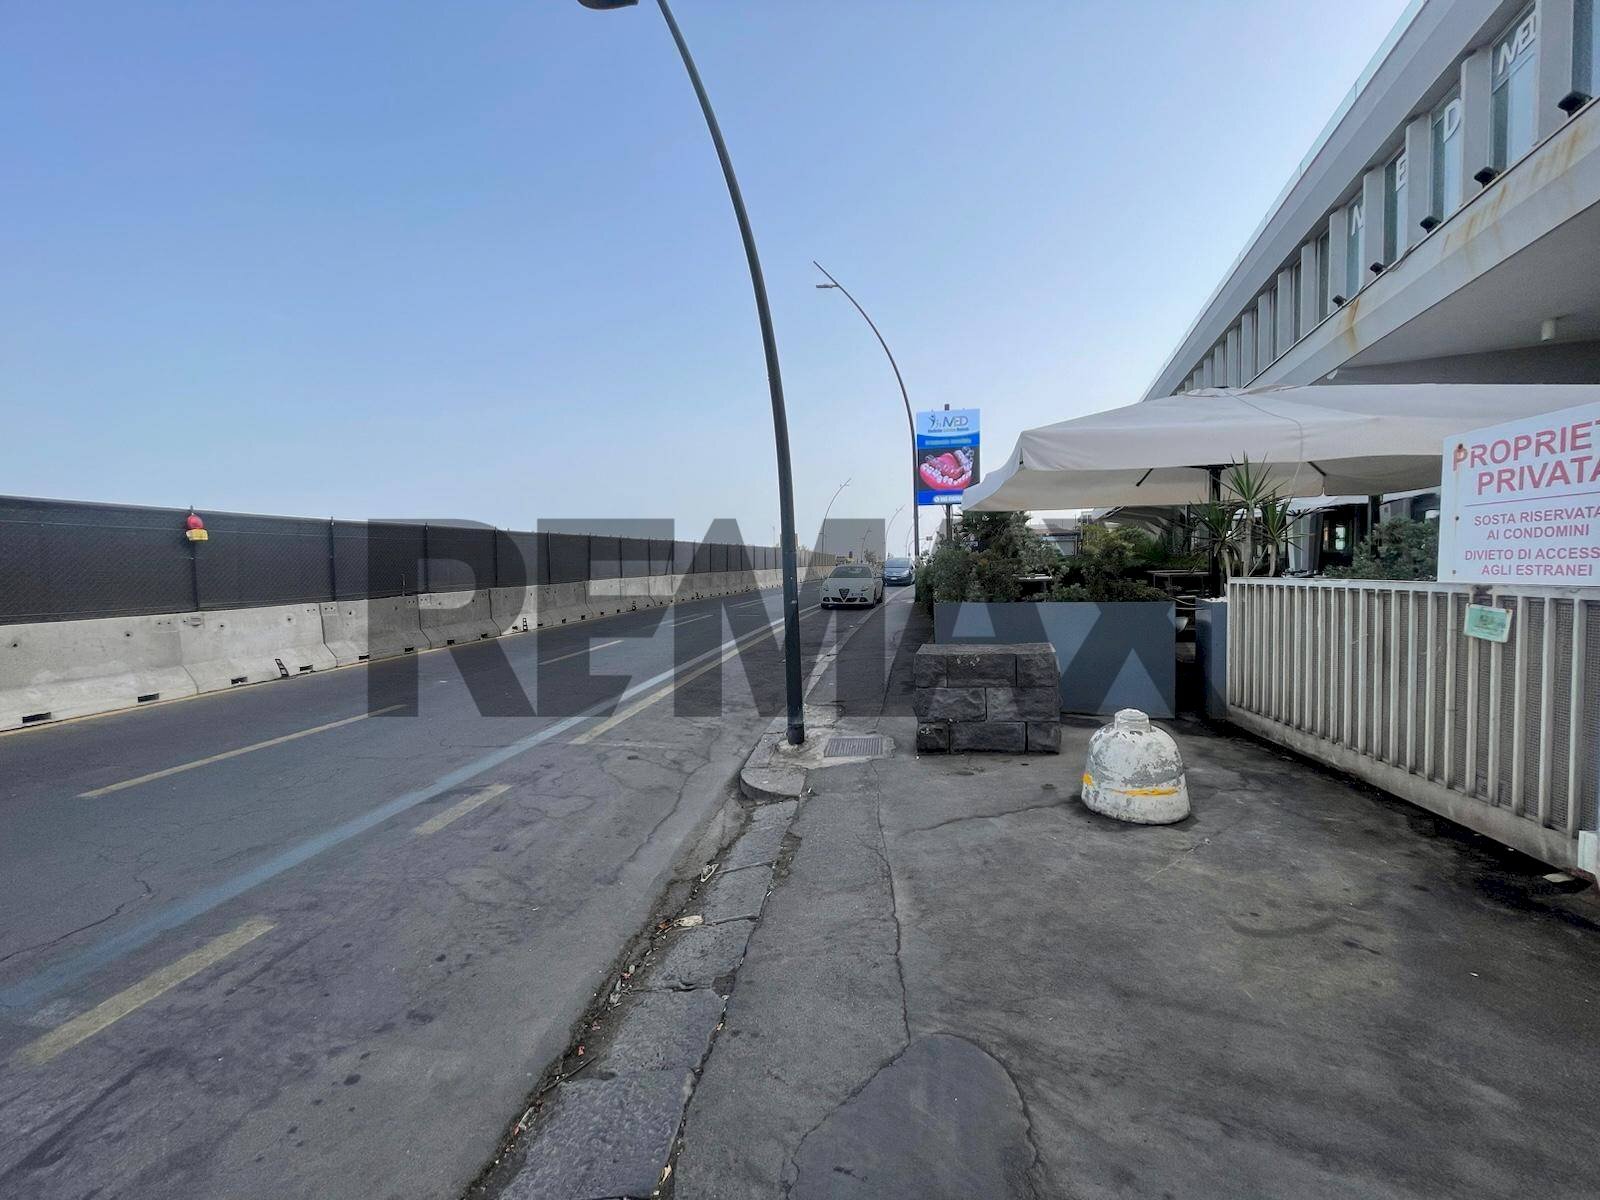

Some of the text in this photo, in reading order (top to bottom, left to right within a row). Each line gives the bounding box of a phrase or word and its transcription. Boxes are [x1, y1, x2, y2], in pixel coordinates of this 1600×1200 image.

[1453, 419, 1600, 471] PROPRIET
[1474, 512, 1516, 526] SOSTA
[1487, 523, 1590, 541] AI CONDOMINI
[1465, 549, 1513, 561] DIVIETO
[1518, 548, 1532, 560] DI
[1481, 564, 1593, 577] AGLI ESTRANEI
